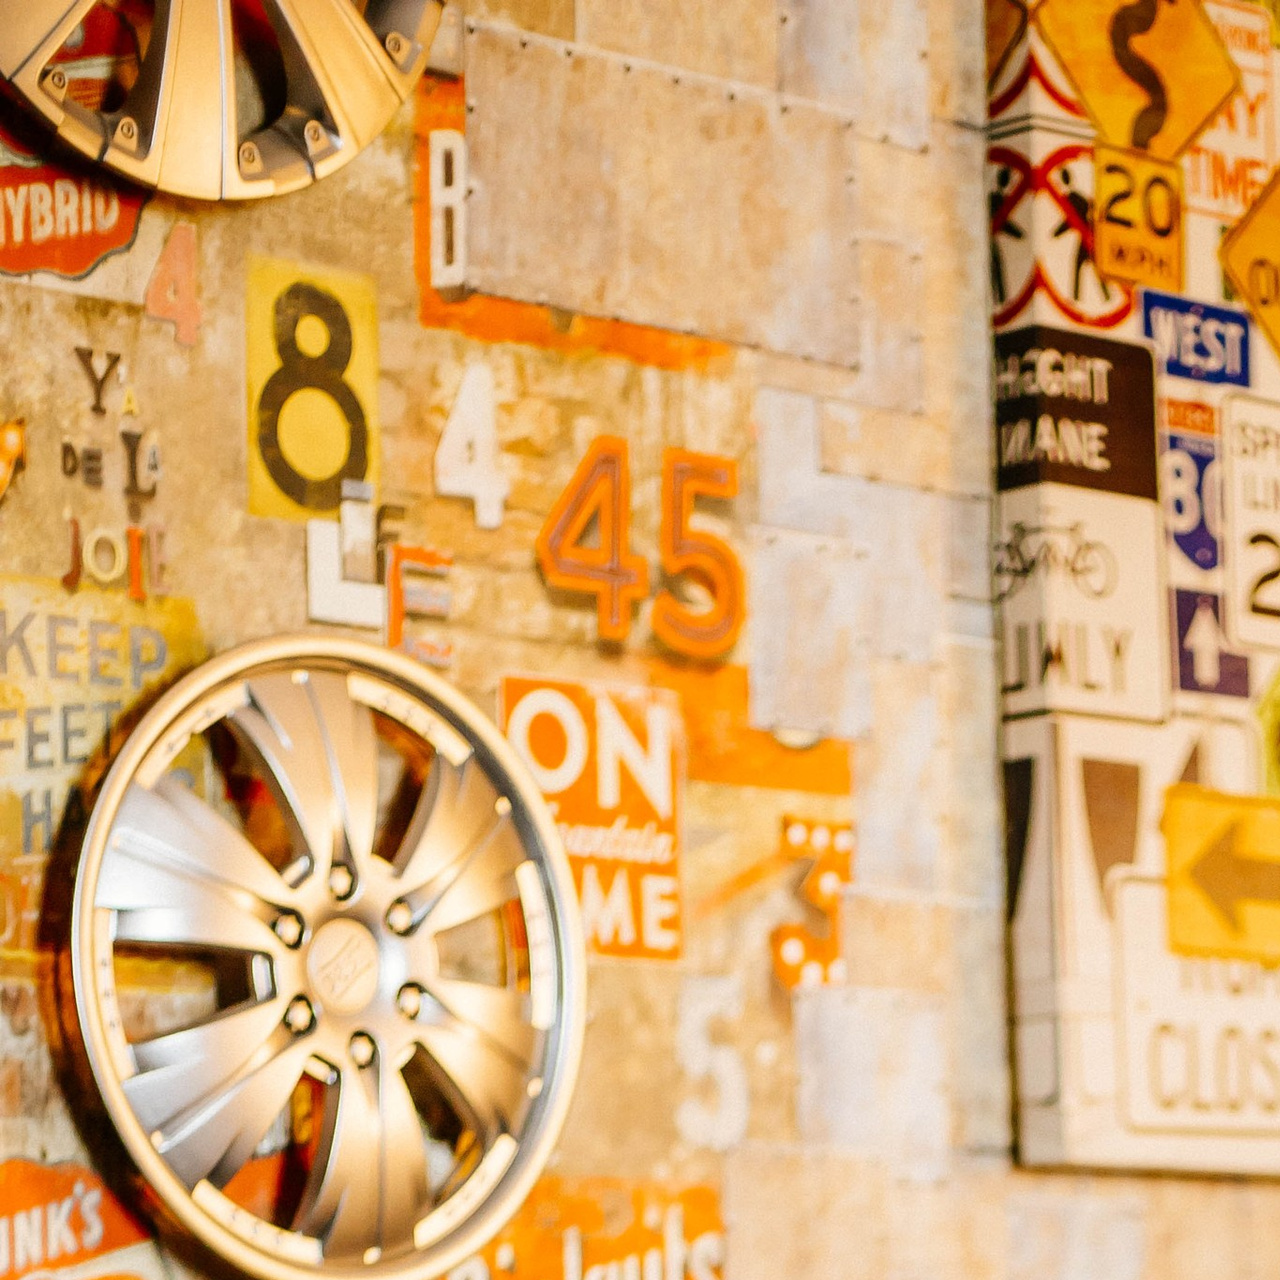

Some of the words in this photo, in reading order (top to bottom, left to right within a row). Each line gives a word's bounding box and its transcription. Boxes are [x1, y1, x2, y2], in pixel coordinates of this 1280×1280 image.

[0, 179, 120, 246] YBRID
[1103, 163, 1177, 238] 20
[257, 281, 368, 511] 8
[1148, 304, 1247, 379] WEST
[434, 364, 511, 529] 4
[536, 435, 748, 665] 45
[507, 688, 673, 822] ON
